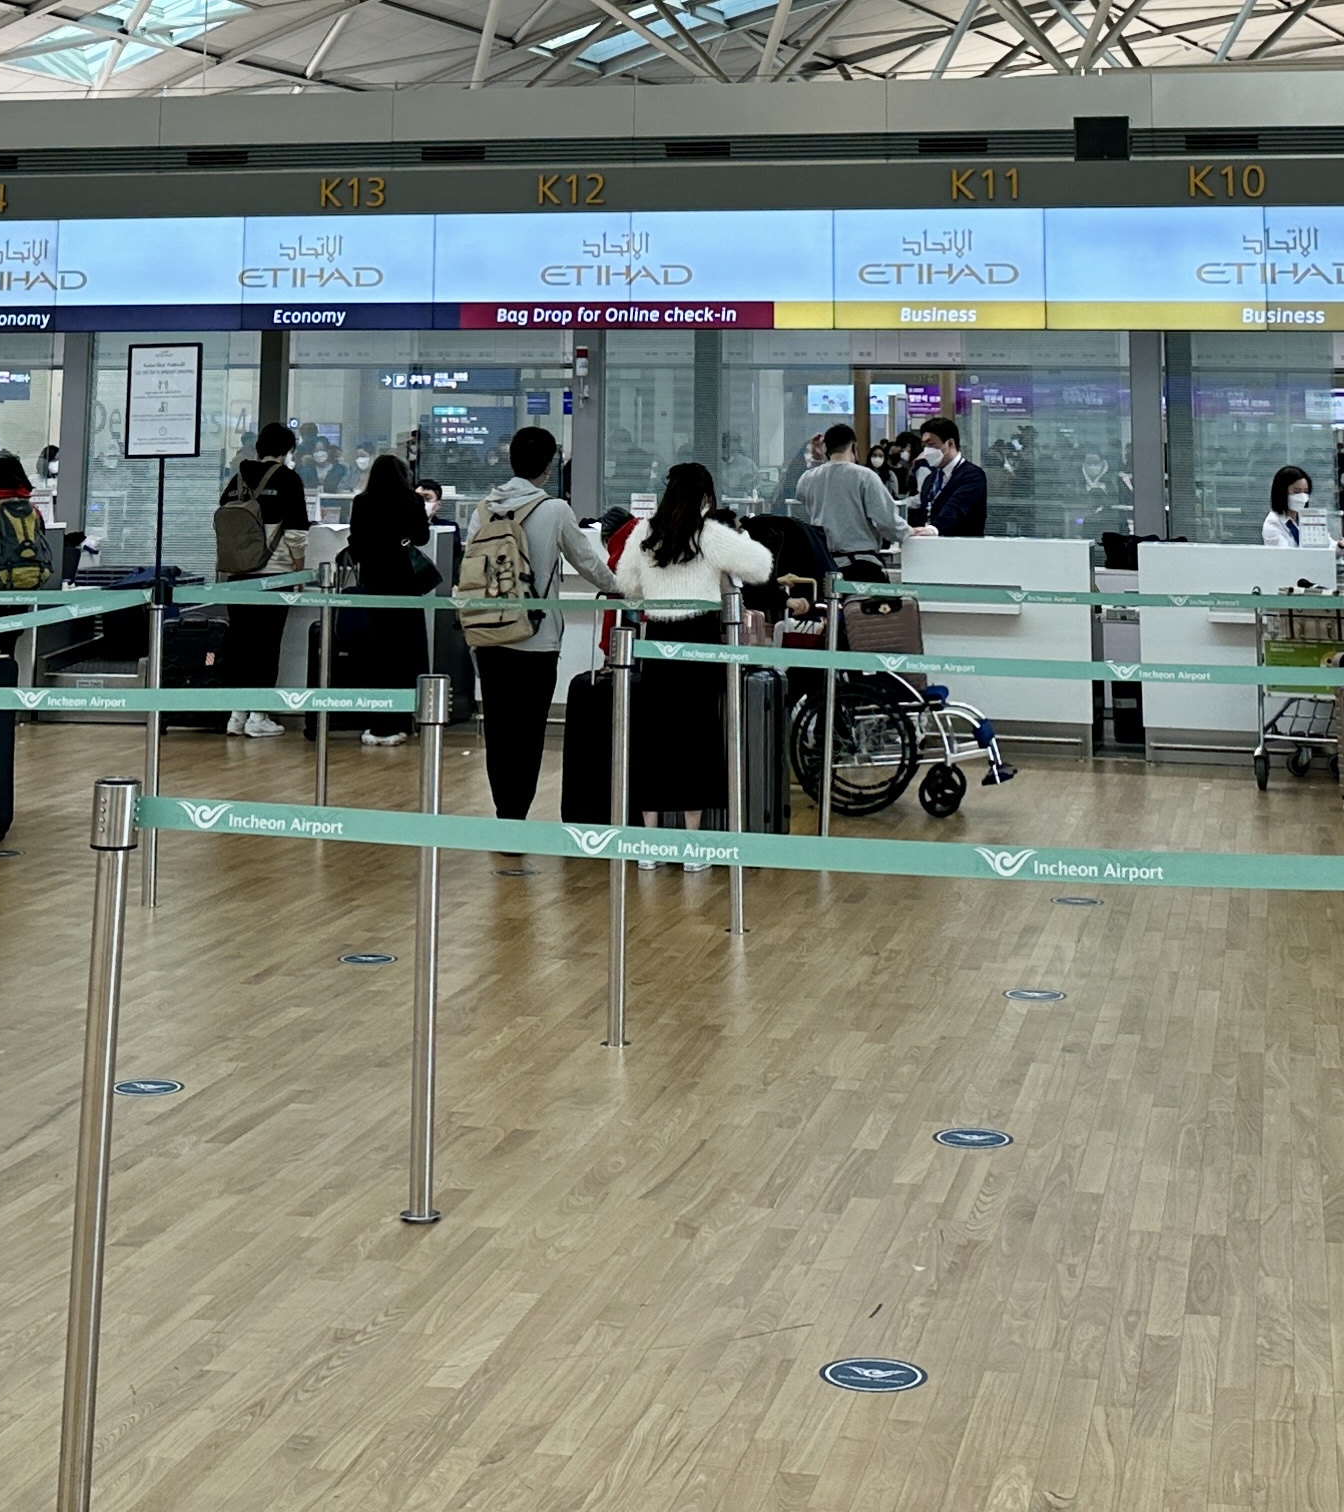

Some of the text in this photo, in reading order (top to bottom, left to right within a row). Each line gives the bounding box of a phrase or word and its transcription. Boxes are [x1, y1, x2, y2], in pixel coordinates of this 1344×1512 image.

[538, 174, 604, 204] K12
[951, 168, 1018, 199] K11
[1189, 165, 1265, 196] K10
[320, 177, 384, 207] K13
[238, 268, 383, 288] ETIHAD
[541, 264, 692, 287] ETIHAD
[859, 264, 1019, 284] ETIHAD
[274, 310, 345, 326] Economy
[497, 307, 736, 325] Bag Drop for Online check-in
[901, 308, 976, 322] Business
[1243, 308, 1324, 323] Business
[718, 652, 748, 662] Airport
[944, 664, 974, 672] Airport
[1139, 671, 1210, 680] Incheon Airport
[48, 697, 125, 709] Incheon Airport
[312, 697, 392, 709] Incheon Airport
[229, 814, 343, 835] Incheon Airport
[618, 840, 738, 861] Incheon Airport
[1034, 861, 1163, 881] Incheon Airport
